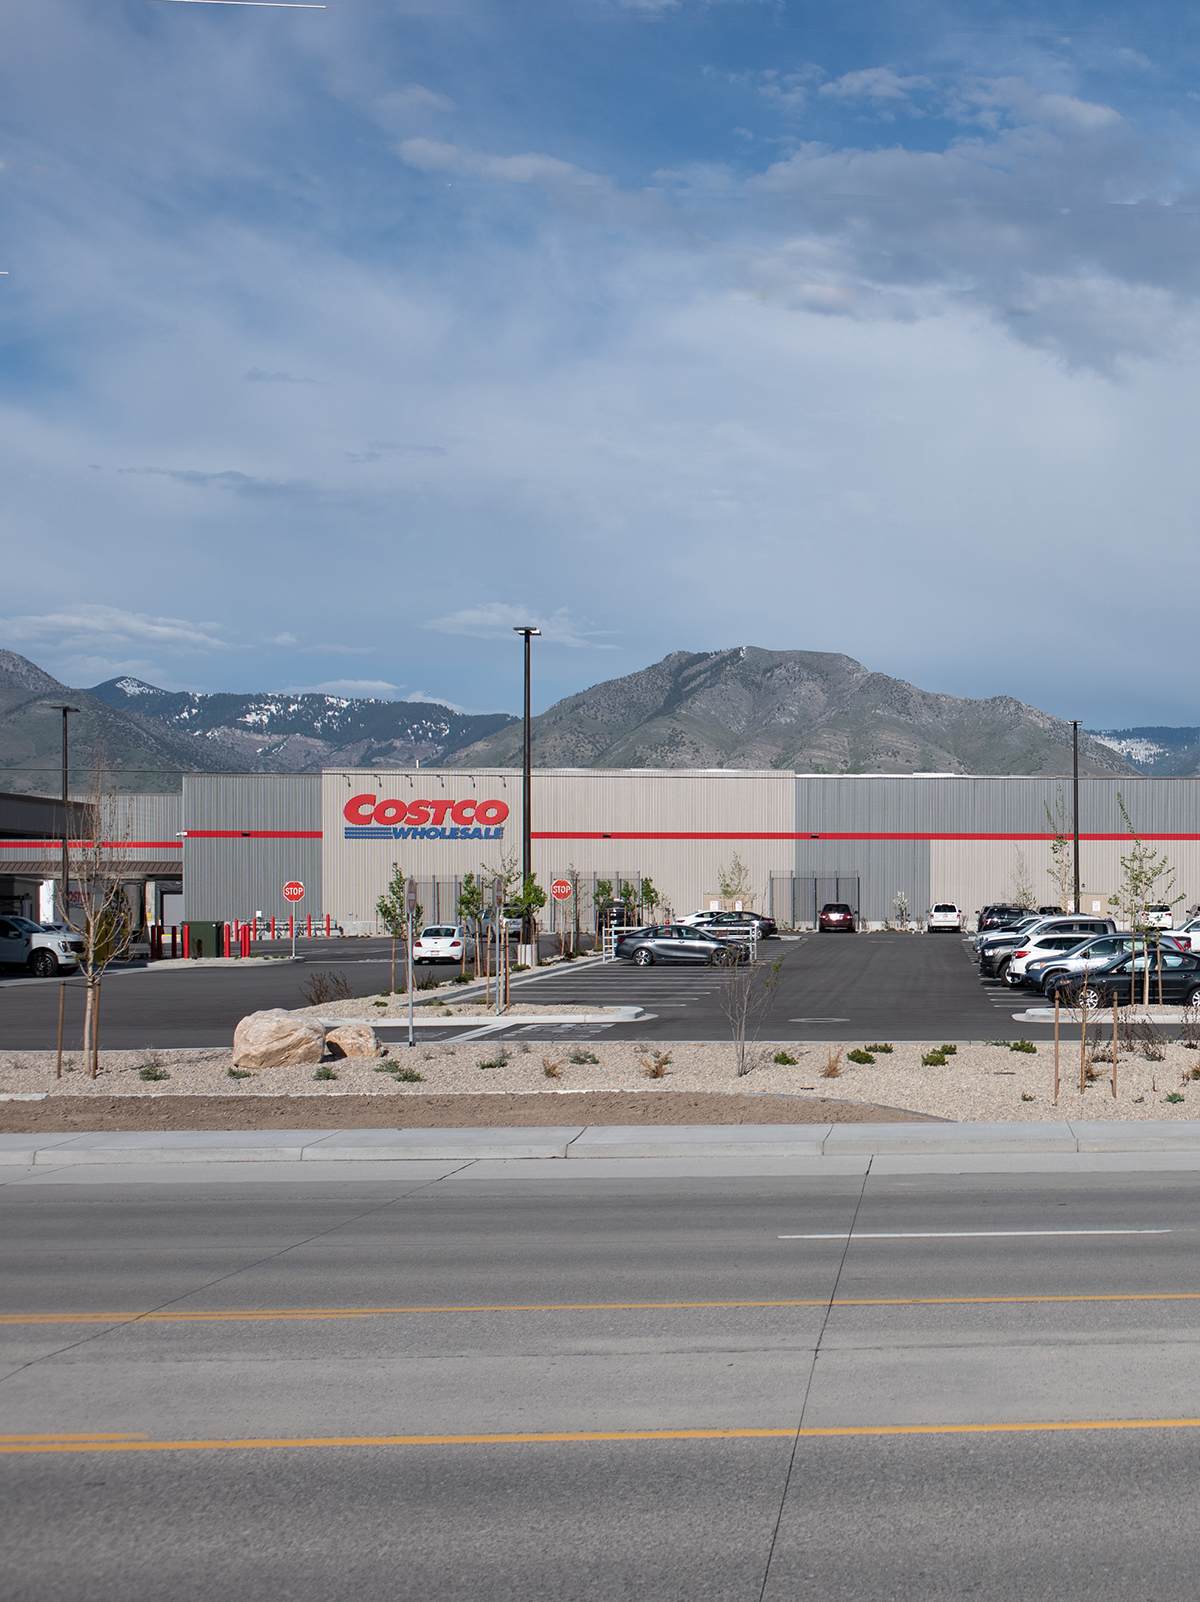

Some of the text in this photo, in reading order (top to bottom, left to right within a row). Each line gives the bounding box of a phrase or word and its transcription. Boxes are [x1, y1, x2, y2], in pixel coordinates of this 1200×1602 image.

[392, 826, 505, 840] WHOLESALE
[285, 887, 304, 896] STOP
[552, 885, 571, 894] STOP
